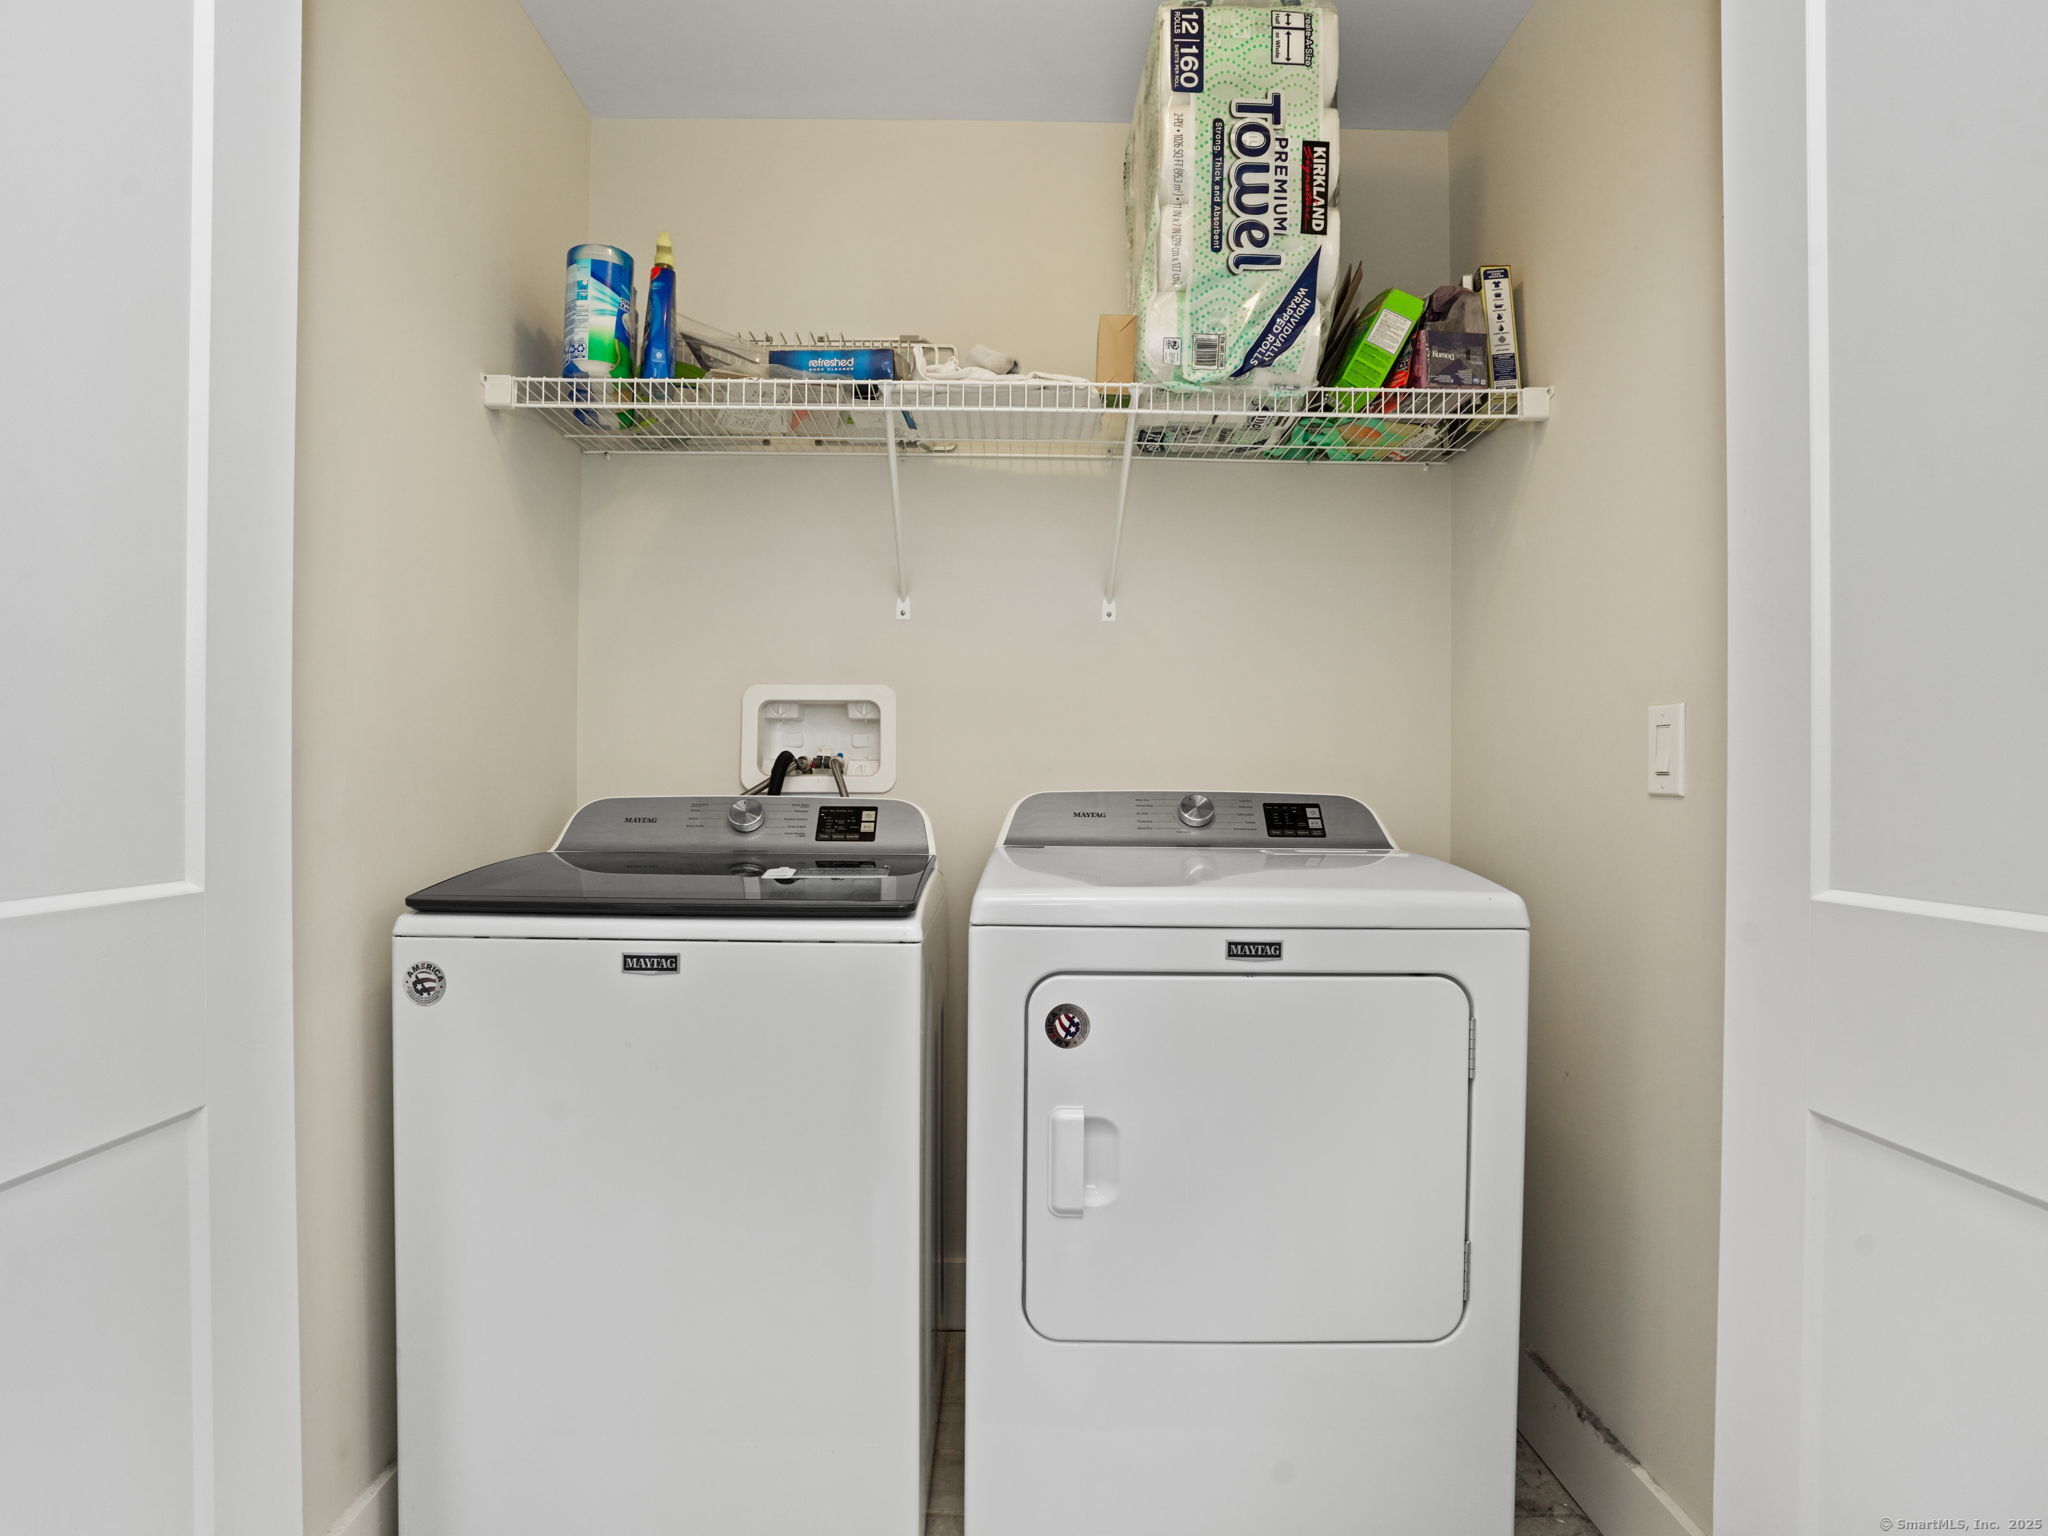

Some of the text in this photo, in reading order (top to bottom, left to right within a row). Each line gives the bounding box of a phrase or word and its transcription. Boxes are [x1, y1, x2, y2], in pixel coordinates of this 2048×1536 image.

[1181, 12, 1199, 34] 12
[1180, 45, 1199, 88] 160
[1212, 121, 1223, 249] Strong, Thick and Absorbent
[1231, 91, 1282, 271] Towel
[1273, 137, 1289, 232] PREMIUM
[1301, 145, 1315, 231] Signature
[1311, 146, 1327, 232] KIRKLAND
[1249, 288, 1308, 366] WRAPPED ROLLS
[1263, 298, 1311, 361] INDIVIDUALLY
[808, 357, 854, 368] refreshed
[623, 816, 658, 824] MAYTAG
[1072, 811, 1107, 819] MAYTAG
[625, 957, 676, 969] MAYTAG
[1230, 944, 1280, 955] MAYTAG
[407, 962, 444, 983] AMERICA
